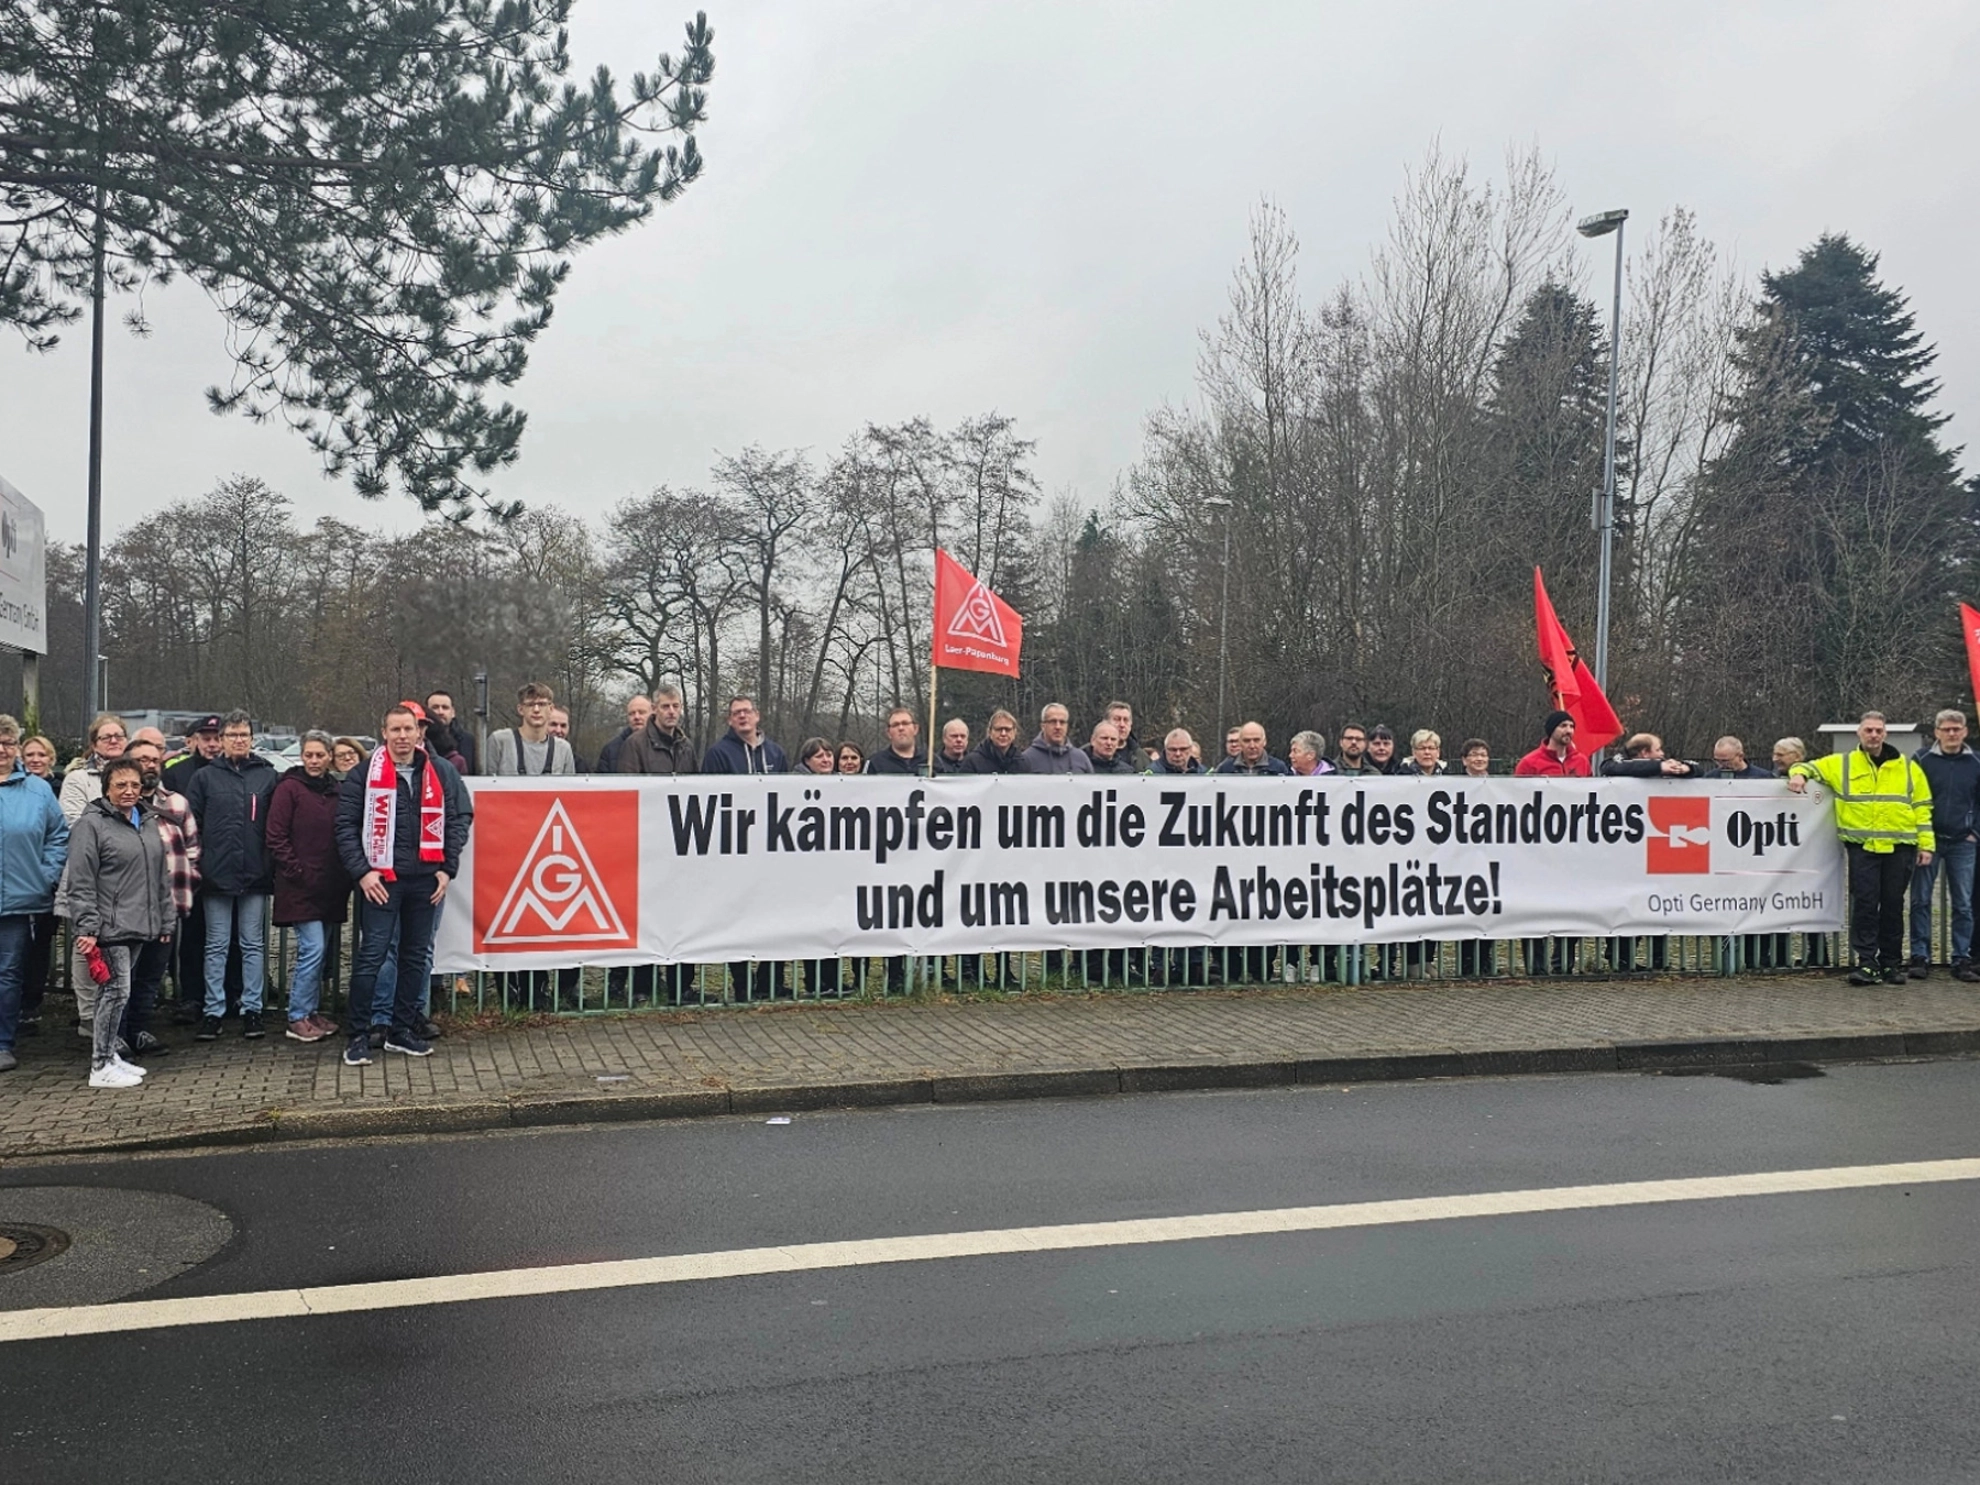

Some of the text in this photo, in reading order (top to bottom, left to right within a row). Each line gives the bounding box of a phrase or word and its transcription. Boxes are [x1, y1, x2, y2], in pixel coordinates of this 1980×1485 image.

[374, 794, 388, 839] WIR
[668, 789, 1645, 863] Wir kämpfen um die Zukunft des Standortes
[1727, 811, 1800, 856] Opti
[857, 860, 1501, 930] und um unsere Arbeitsplätze!
[1648, 892, 1824, 915] Opti Germany GmbH
